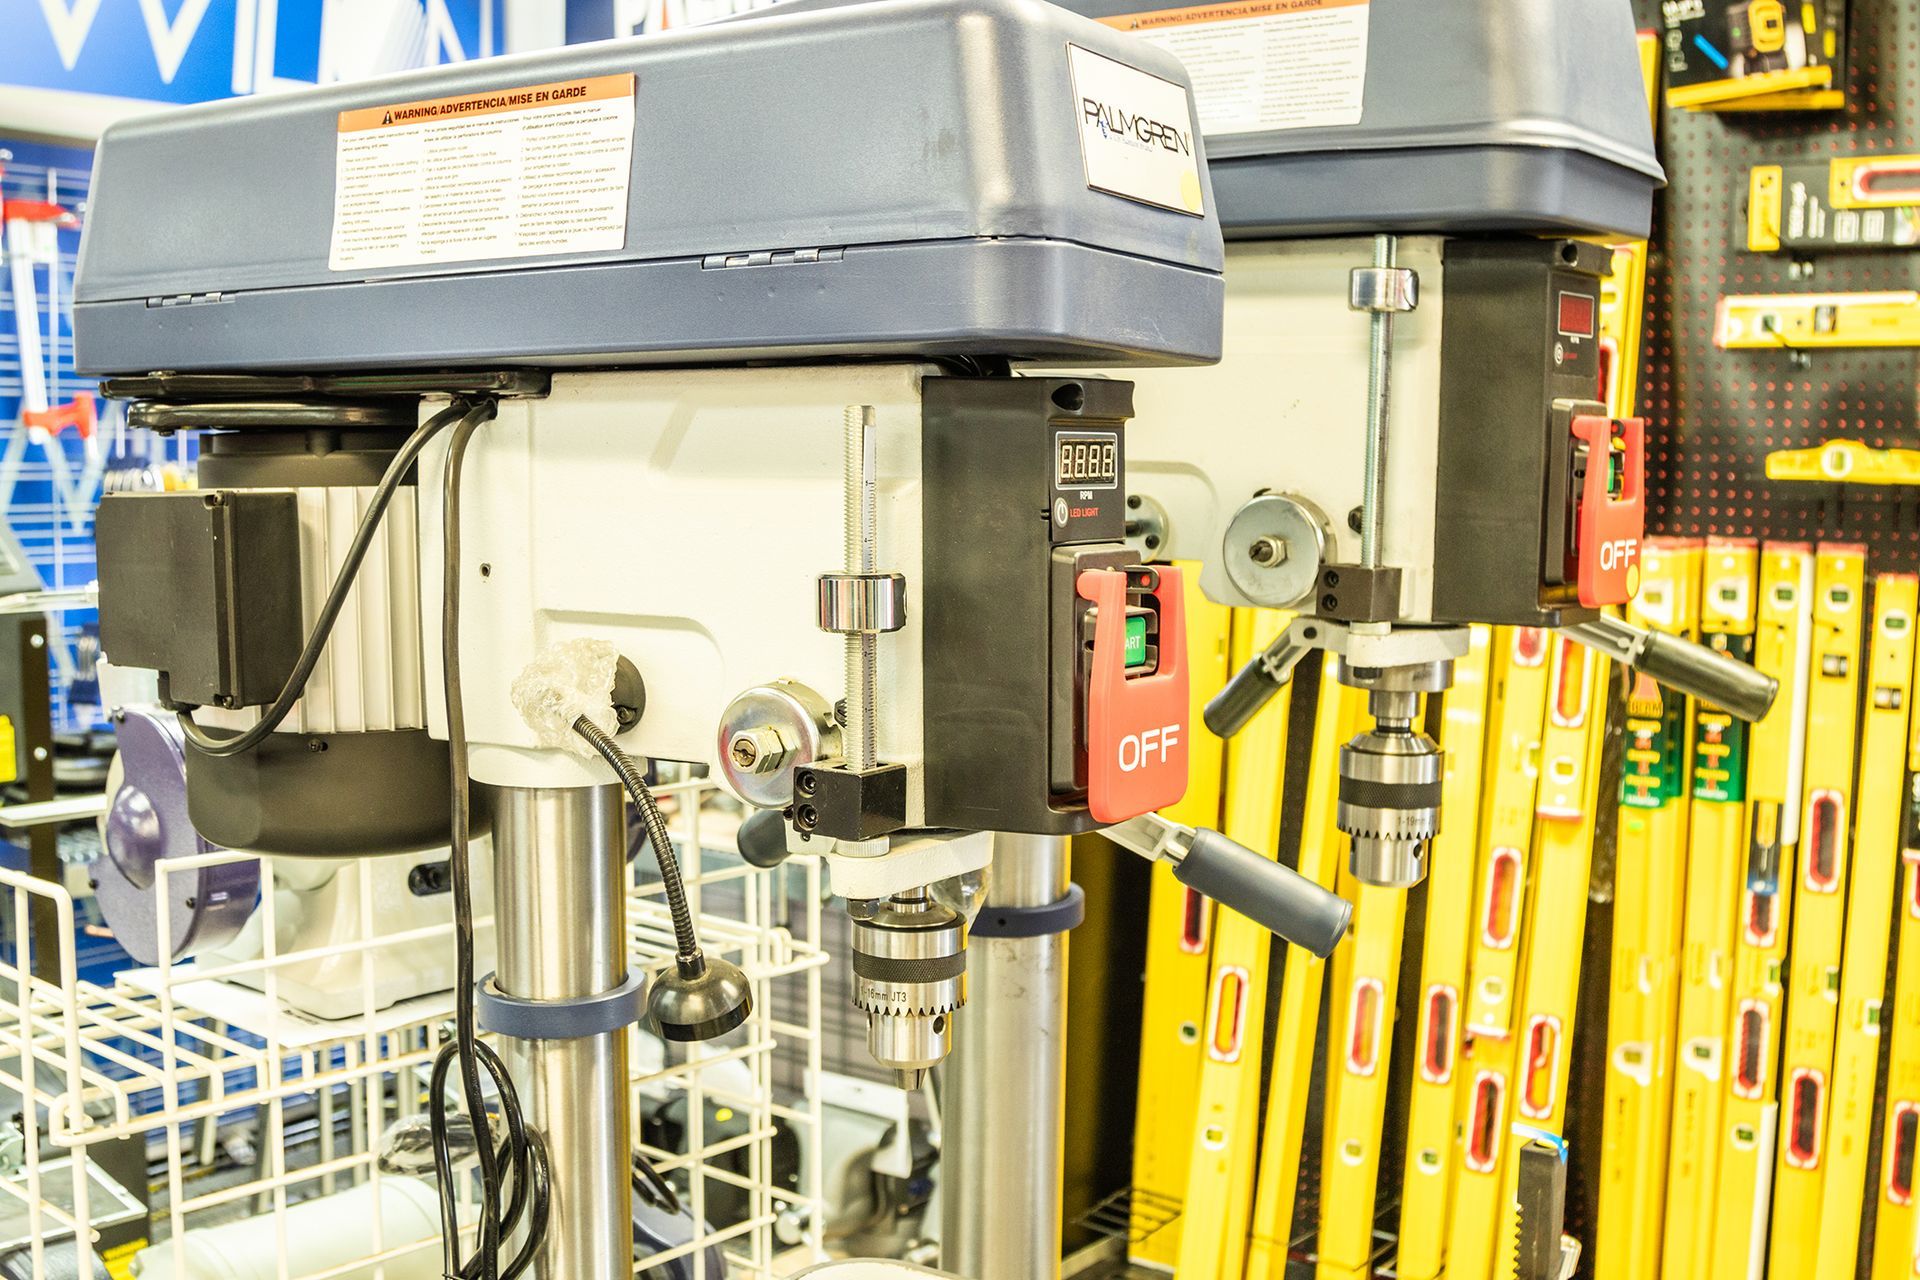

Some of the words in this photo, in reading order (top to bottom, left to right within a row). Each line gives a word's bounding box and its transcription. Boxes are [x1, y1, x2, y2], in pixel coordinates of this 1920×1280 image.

[536, 91, 549, 102] EN
[552, 86, 587, 100] GARDE
[1083, 97, 1190, 157] PALMGREN
[1080, 491, 1093, 500] RPM
[1070, 508, 1081, 518] LED
[1082, 507, 1099, 517] LIGHT
[1600, 539, 1637, 571] OFF
[1125, 635, 1141, 649] ART
[1118, 724, 1180, 772] OFF
[891, 991, 907, 1003] JT3
